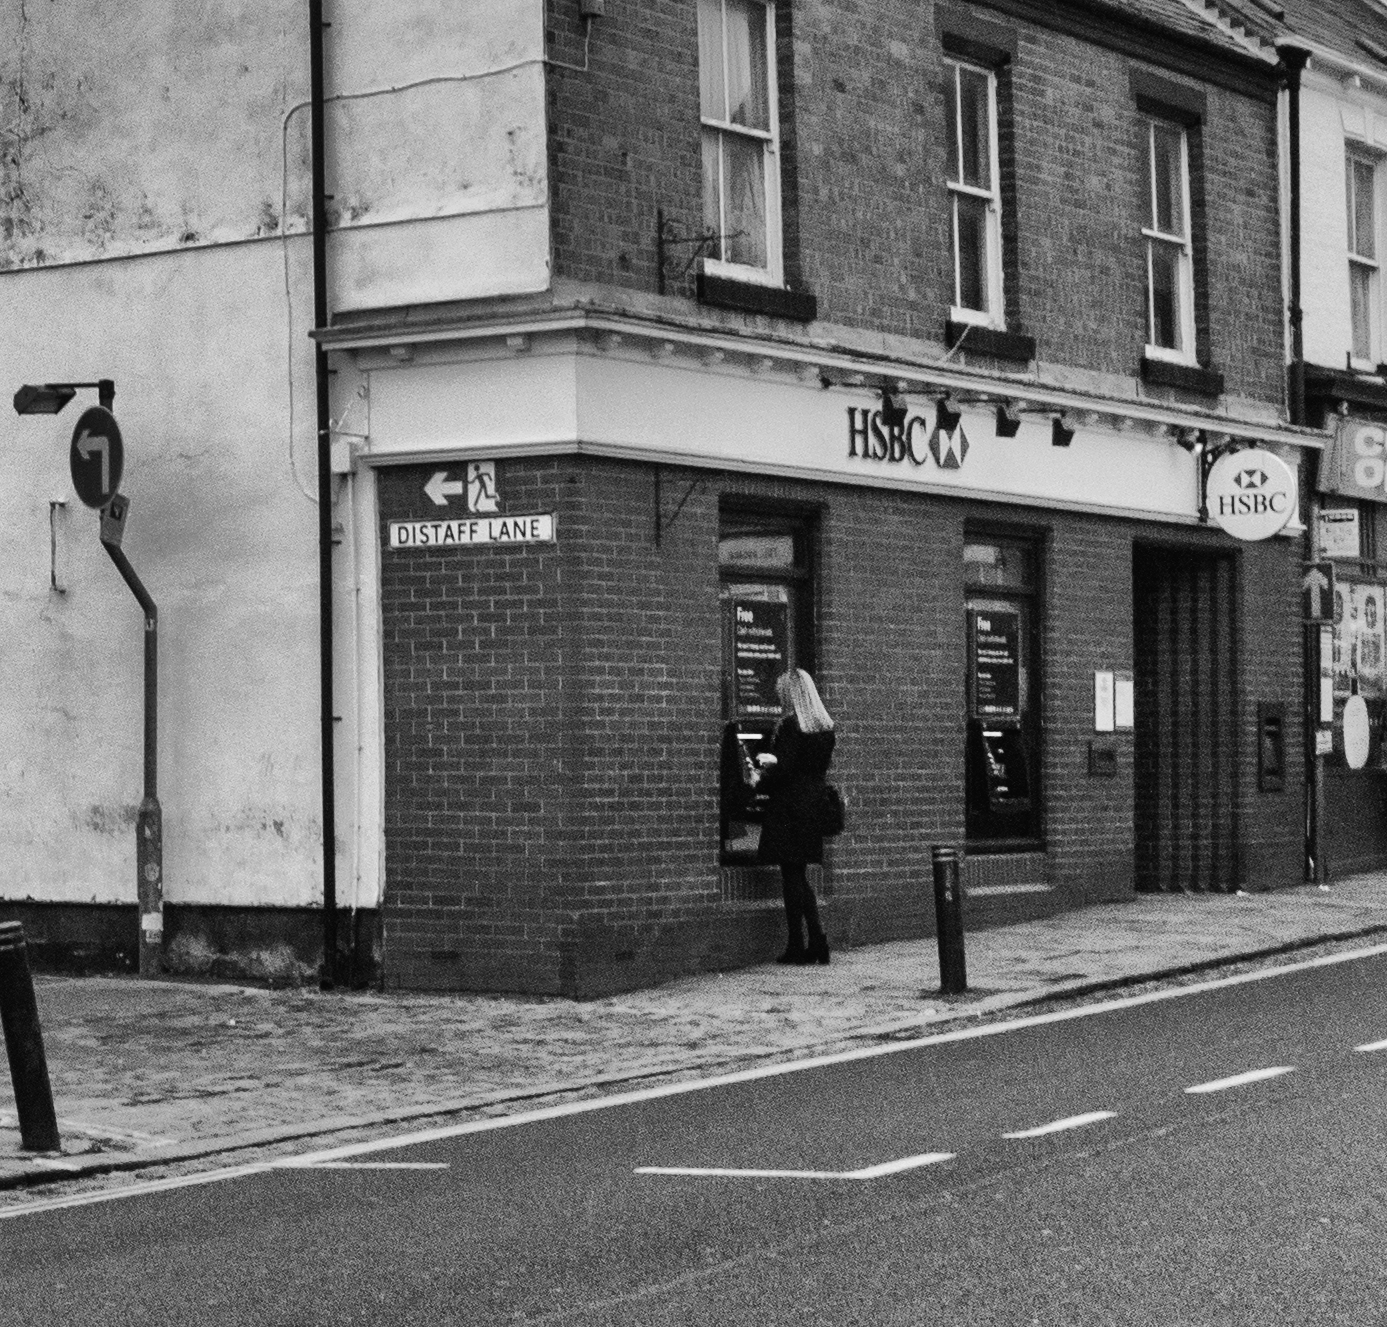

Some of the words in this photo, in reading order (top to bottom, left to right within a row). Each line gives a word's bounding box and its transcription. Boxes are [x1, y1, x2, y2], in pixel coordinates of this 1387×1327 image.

[847, 407, 928, 466] HSBC
[1218, 492, 1288, 517] HSBC
[397, 521, 479, 546] DISTAFF
[488, 519, 541, 542] LANE
